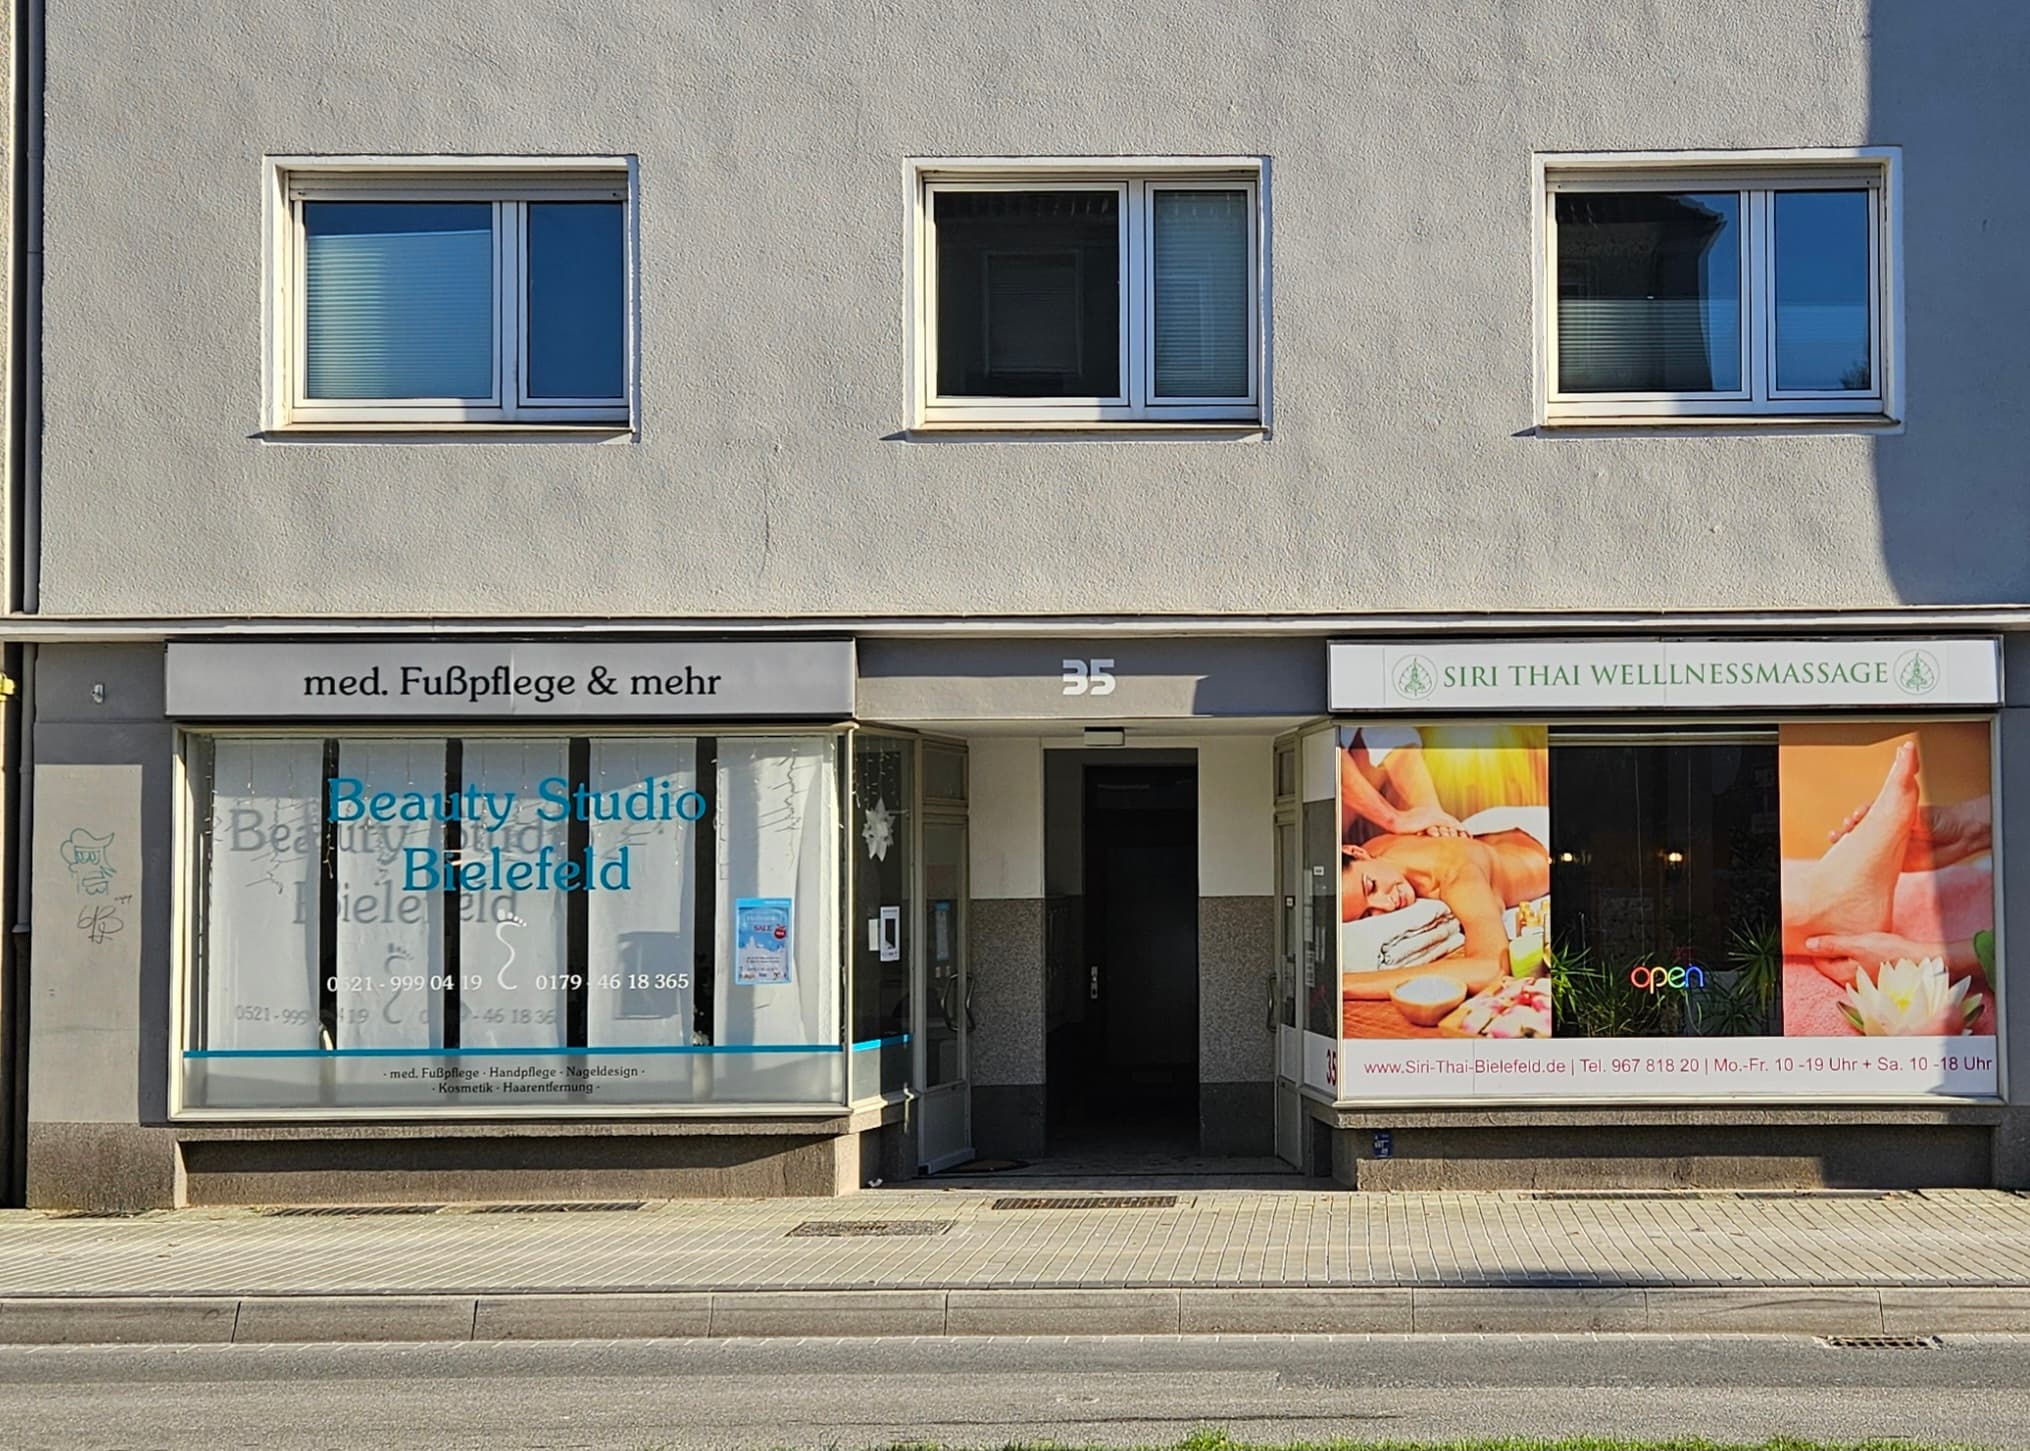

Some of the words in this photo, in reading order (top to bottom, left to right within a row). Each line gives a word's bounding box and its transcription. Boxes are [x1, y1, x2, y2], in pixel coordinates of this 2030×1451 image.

[304, 666, 388, 696] med.
[400, 665, 576, 703] Fußpflege
[587, 665, 619, 696] &
[630, 665, 722, 696] mehr
[1062, 659, 1116, 695] 35
[1443, 665, 1499, 688] SIRI
[1508, 664, 1581, 687] THAI
[1591, 661, 1889, 686] WELLLNESSMASSAGE
[327, 777, 517, 832] Beauty
[537, 776, 707, 822] Studio
[402, 845, 632, 892] Bielefeld
[1631, 966, 1704, 995] open
[390, 1068, 419, 1079] med.
[421, 1066, 480, 1081] Fußpflege
[489, 1066, 557, 1080] Handpflege
[566, 1065, 639, 1079] Nageldesign
[1326, 1049, 1337, 1086] 35
[1363, 1057, 1566, 1075] www.Siri-Thai-Bielefeld.de
[1579, 1058, 1607, 1073] Tel.
[1612, 1058, 1641, 1073] 967
[1646, 1058, 1676, 1073] 818
[1680, 1057, 1700, 1073] 20
[1714, 1058, 1769, 1073] Mo.-Fr.
[1775, 1057, 1794, 1072] 10
[1829, 1056, 1858, 1072] Uhr
[1877, 1056, 1903, 1072] Sa.
[1909, 1056, 1928, 1071] 10
[1963, 1055, 1993, 1071] Uhr
[438, 1082, 494, 1094] Kosmetik
[503, 1080, 594, 1095] Haarentfernung
